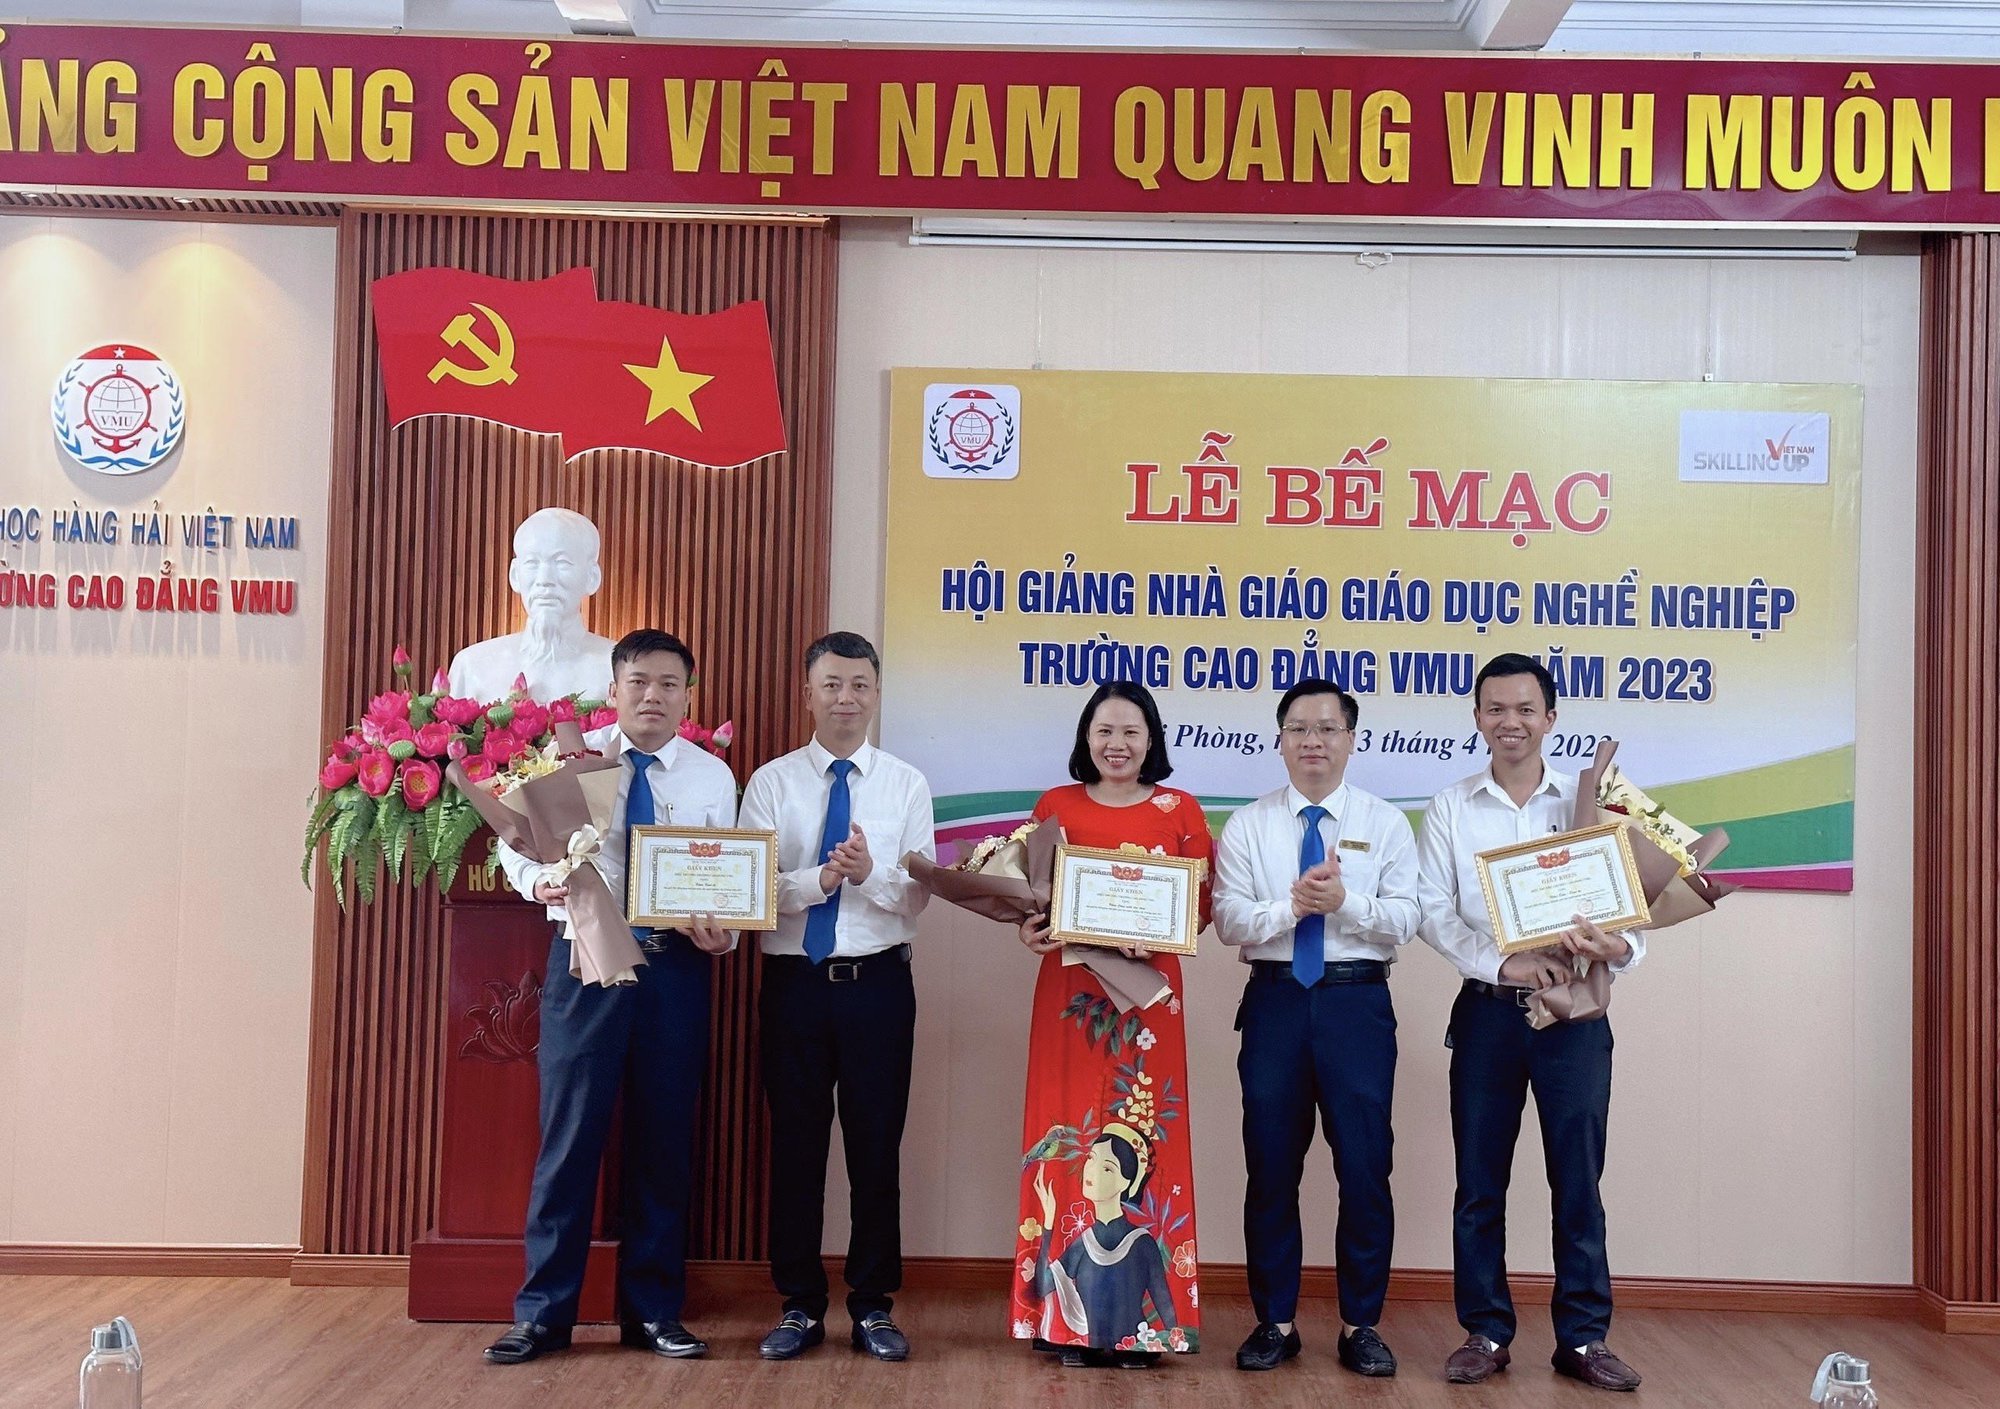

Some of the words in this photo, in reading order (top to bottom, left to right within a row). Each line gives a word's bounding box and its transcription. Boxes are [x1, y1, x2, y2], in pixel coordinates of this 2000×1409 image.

[0, 28, 137, 153] NG
[173, 43, 413, 181] CỘNG
[445, 42, 629, 171] SẢN
[664, 59, 848, 197] VIỆT
[879, 82, 1080, 179] NAM
[1114, 85, 1411, 190] QUANG
[1444, 91, 1654, 188] VINH
[1685, 71, 1952, 192] MUÔN
[101, 415, 133, 428] VMU
[960, 436, 983, 445] VMU
[1783, 455, 1810, 472] UP
[1797, 446, 1815, 454] NAM
[1126, 431, 1238, 522] LỄ
[1266, 437, 1389, 527] BẾ
[1408, 471, 1610, 548] MẠC
[53, 500, 118, 545] HÀNG
[131, 500, 169, 546] HẢI
[181, 505, 233, 553] VIỆT
[245, 516, 296, 549] NAM
[67, 574, 123, 609] CAO
[136, 560, 219, 612] ĐẲNG
[231, 579, 295, 614] VMU
[942, 561, 1005, 621] HỘI
[1019, 553, 1134, 615] GIẢNG
[1149, 566, 1227, 617] NHÀ
[1239, 568, 1328, 620] GIÁO
[1342, 571, 1430, 623] GIÁO
[1444, 581, 1520, 633] DỤC
[1534, 569, 1640, 627] NGHỀ
[1651, 578, 1795, 640] NGHIỆP
[1019, 632, 1169, 688] TRƯỜNG
[1183, 647, 1259, 689] CAO
[1271, 629, 1376, 693] ĐẲNG
[1390, 652, 1473, 697] VMU
[1531, 646, 1604, 698] ĂM
[1619, 657, 1713, 702] 2023
[1174, 724, 1264, 755] Phòng,
[1357, 729, 1372, 752] 3
[1381, 730, 1455, 760] tháng
[1462, 732, 1479, 755] 4
[1551, 734, 1612, 758] 202
